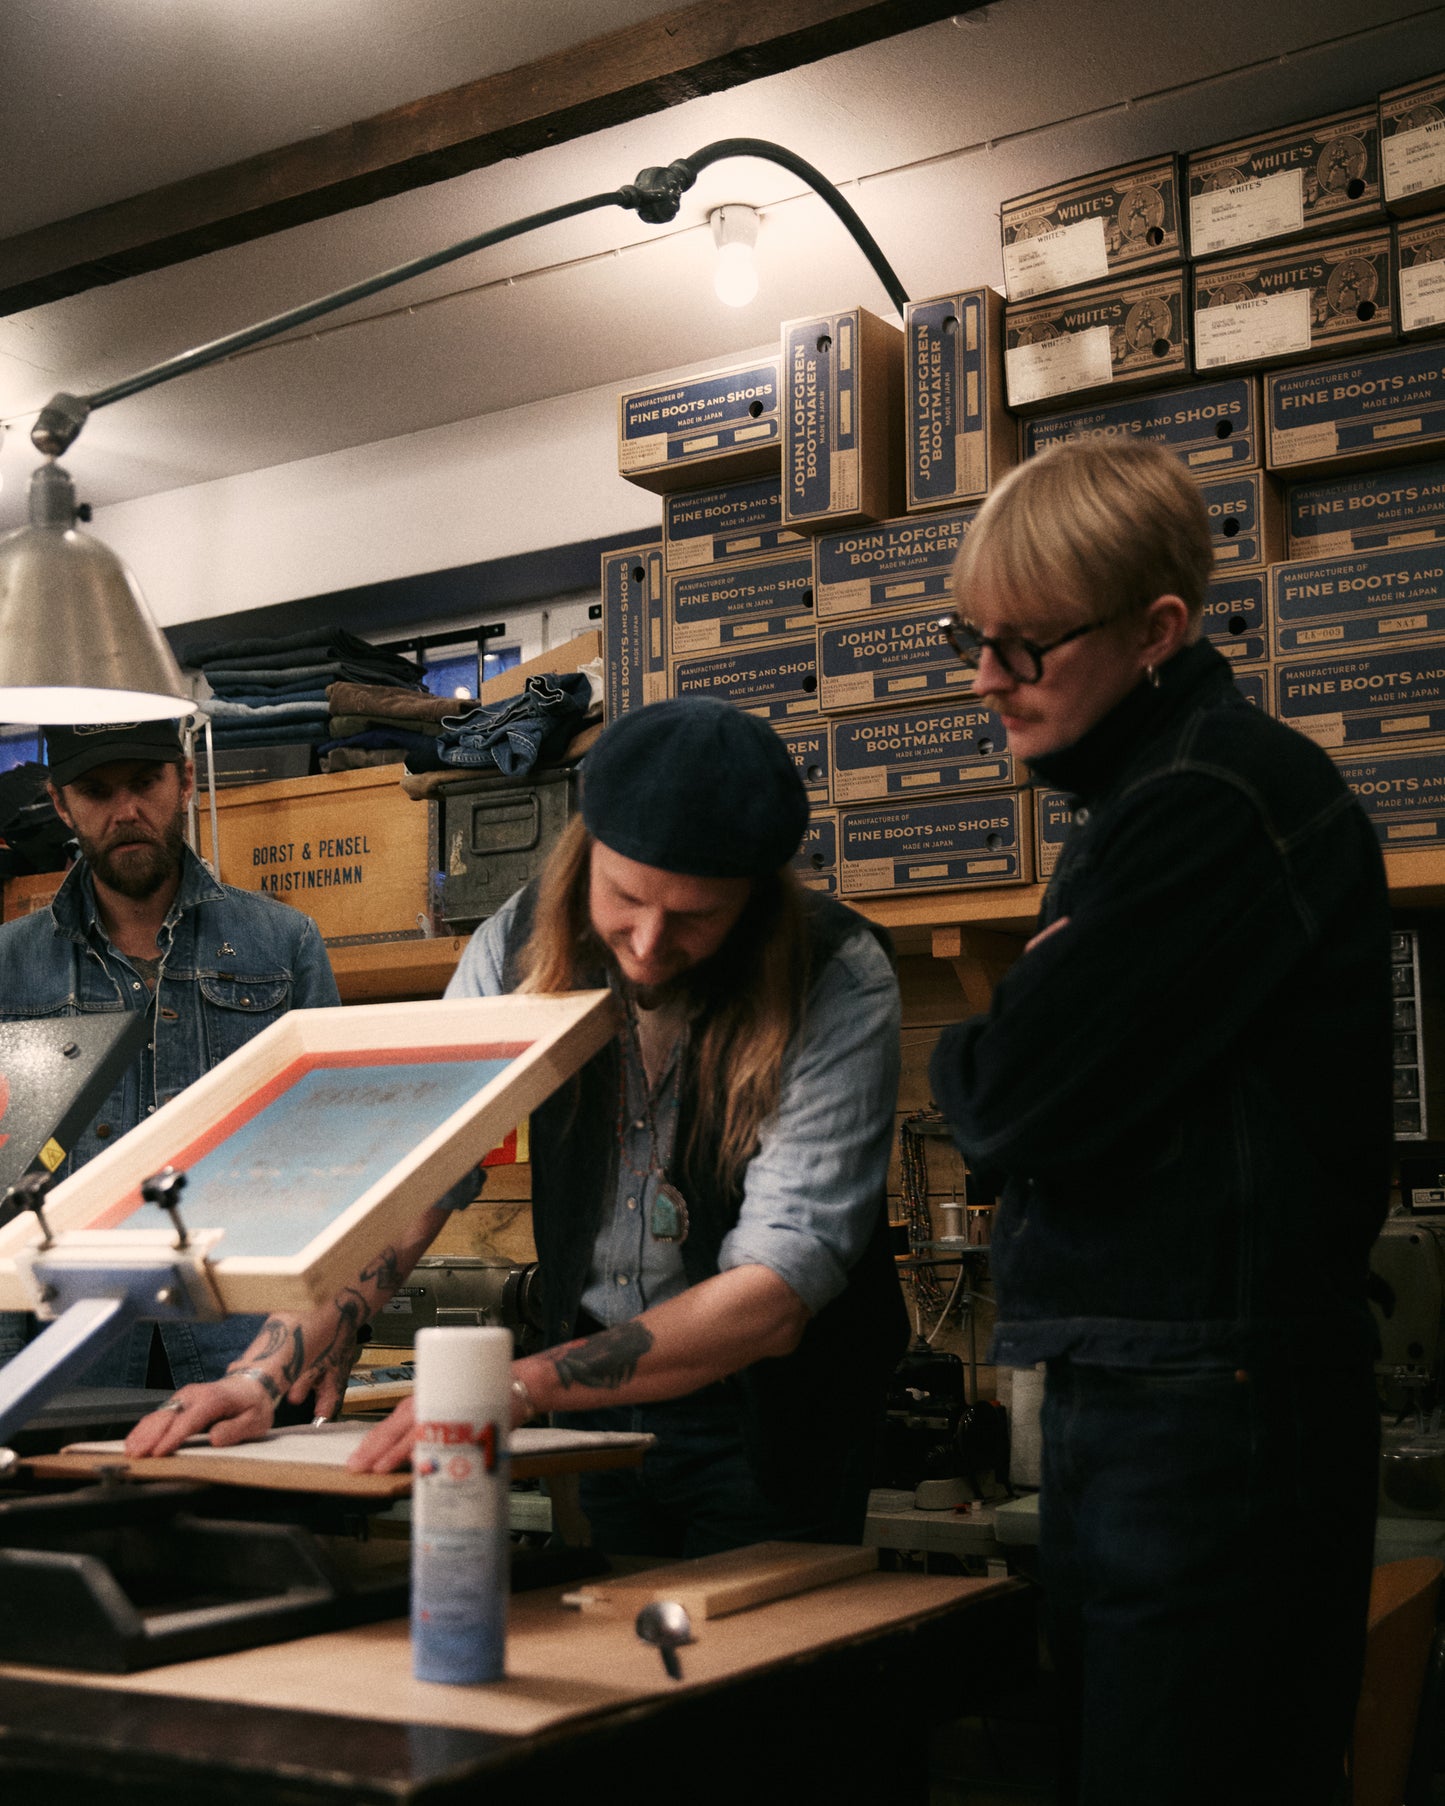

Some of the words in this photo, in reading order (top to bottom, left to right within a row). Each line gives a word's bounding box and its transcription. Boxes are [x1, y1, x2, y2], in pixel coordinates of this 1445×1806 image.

[1251, 145, 1313, 171] WHITE'S
[1229, 181, 1261, 194] WHITE'S
[1058, 195, 1114, 220] WHITE'S
[1038, 230, 1066, 242] WHITE'S
[1260, 265, 1323, 288] WHITE'S
[1065, 305, 1122, 327] WHITE'S
[1235, 300, 1268, 311] WHITE'S
[918, 324, 929, 420] LOFGREN
[1280, 373, 1349, 392] MANUFACTURER
[1351, 369, 1362, 378] OF
[630, 394, 675, 409] MANUFACTURER
[676, 392, 684, 400] OF
[795, 344, 805, 437] LOFGREN
[930, 340, 942, 461] BOOTMAKER
[945, 396, 950, 406] IN
[1281, 391, 1328, 410] FINE
[1333, 376, 1404, 400] BOOTS
[1408, 371, 1438, 384] AND
[1363, 398, 1387, 409] MADE
[1402, 390, 1432, 402] JAPAN
[630, 410, 659, 425] FINE
[662, 399, 705, 418] BOOTS
[707, 396, 725, 406] AND
[727, 384, 773, 403] SHOES
[1146, 416, 1172, 428] AND
[1175, 401, 1241, 424] SHOES
[678, 418, 694, 426] MADE
[704, 412, 723, 421] JAPAN
[807, 360, 817, 478] BOOTMAKER
[820, 415, 824, 424] IN
[1033, 417, 1093, 434] MANUFACTURER
[1095, 414, 1105, 423] OF
[919, 425, 930, 480] JOHN
[795, 443, 805, 497] JOHN
[672, 496, 718, 509] MANUFACTURER
[1297, 484, 1365, 499] MANUFACTURER
[1298, 500, 1345, 518] FINE
[1349, 487, 1418, 510] BOOTS
[673, 511, 702, 524] FINE
[705, 501, 747, 518] BOOTS
[750, 499, 768, 507] AND
[746, 514, 765, 522] JAPAN
[1208, 500, 1247, 516] OES
[1378, 510, 1402, 519] MADE
[1416, 502, 1445, 514] JAPAN
[835, 536, 883, 554] JOHN
[890, 521, 972, 544] LOFGREN
[850, 537, 958, 565] BOOTMAKER
[879, 562, 897, 570] MADE
[907, 557, 928, 566] JAPAN
[1284, 566, 1354, 583] MANUFACTURER
[1357, 564, 1368, 572] OF
[620, 562, 628, 612] SHOES
[679, 579, 726, 591] MANUFACTURER
[680, 593, 709, 607] FINE
[712, 586, 755, 601] BOOTS
[758, 584, 776, 592] AND
[778, 576, 814, 591] SHOE
[1286, 583, 1333, 600] FINE
[1338, 571, 1409, 593] BOOTS
[1413, 568, 1444, 580] AND
[1368, 594, 1394, 603] MADE
[1396, 592, 1405, 600] IN
[1408, 586, 1437, 598] JAPAN
[728, 603, 745, 611] MADE
[754, 598, 774, 607] JAPAN
[1202, 598, 1255, 616] HOES
[838, 630, 886, 647] JOHN
[854, 634, 948, 658] BOOTMAKE
[612, 662, 617, 670] OF
[621, 634, 629, 686] BOOTS
[882, 656, 900, 664] MADE
[910, 651, 929, 660] JAPAN
[681, 663, 727, 675] MANUFACTURER
[682, 678, 711, 691] FINE
[713, 670, 757, 685] BOOTS
[759, 668, 777, 677] AND
[779, 660, 815, 675] SHOE
[1287, 665, 1356, 680] MANUFACTURER
[1359, 663, 1370, 671] OF
[756, 683, 775, 691] JAPAN
[1288, 681, 1335, 698] FINE
[1340, 672, 1412, 692] BOOTS
[1416, 669, 1445, 680] AND
[622, 688, 630, 713] INE
[1370, 693, 1396, 702] MADE
[1398, 691, 1408, 699] IN
[1410, 688, 1440, 698] JAPAN
[851, 724, 899, 741] JOHN
[904, 712, 990, 734] LOFGREN
[866, 729, 974, 752] BOOTMAKER
[923, 747, 943, 755] JAPAN
[1377, 799, 1402, 807] MADE
[848, 816, 899, 826] MANUFACTURER
[849, 830, 880, 842] FINE
[884, 824, 933, 839] BOOTS
[936, 824, 956, 833] AND
[958, 817, 1009, 831] SHOES
[253, 844, 294, 866] BORST
[302, 842, 311, 860] &
[320, 836, 371, 858] PENSEL
[261, 865, 362, 891] KRISTINEHAMN
